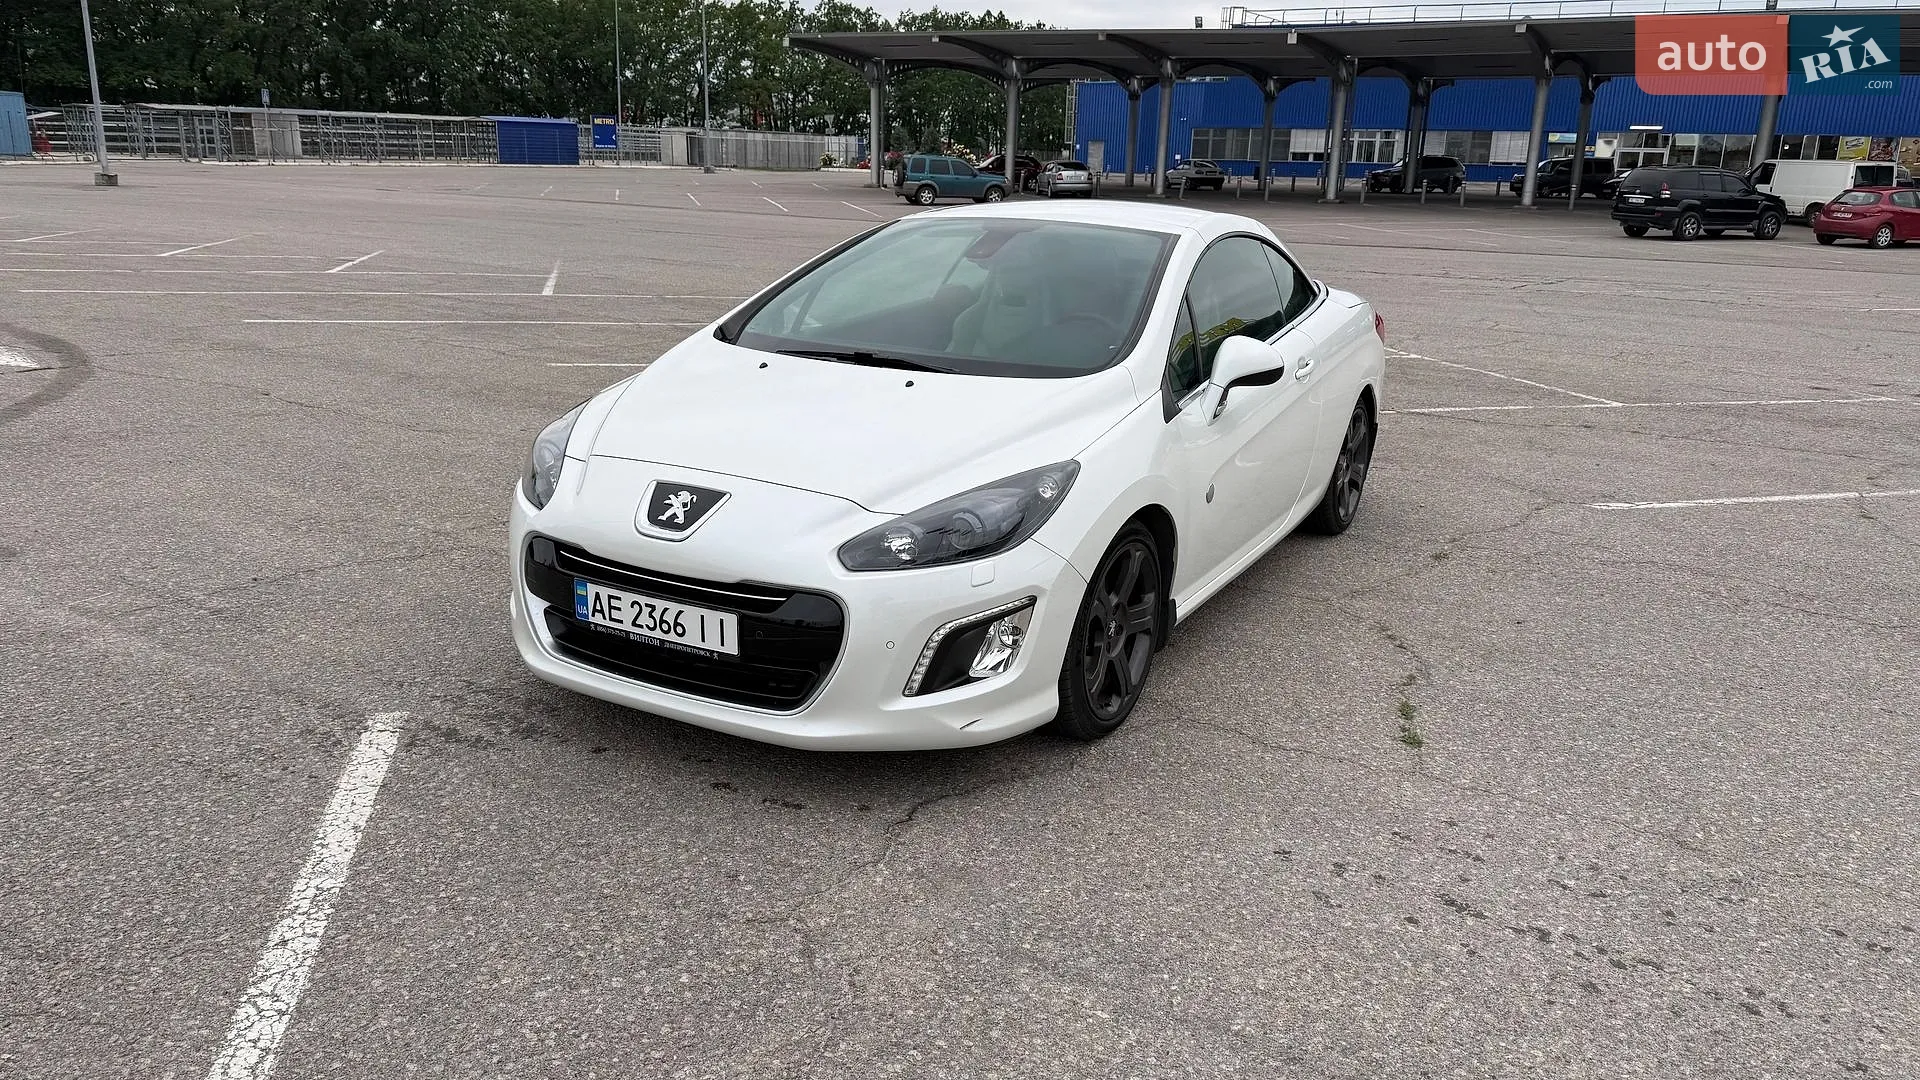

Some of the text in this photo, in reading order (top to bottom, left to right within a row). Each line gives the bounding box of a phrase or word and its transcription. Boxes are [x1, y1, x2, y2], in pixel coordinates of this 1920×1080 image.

[577, 604, 588, 614] UA
[591, 591, 624, 625] AE
[630, 600, 686, 638] 2366
[629, 633, 660, 646] ВИЛТОН
